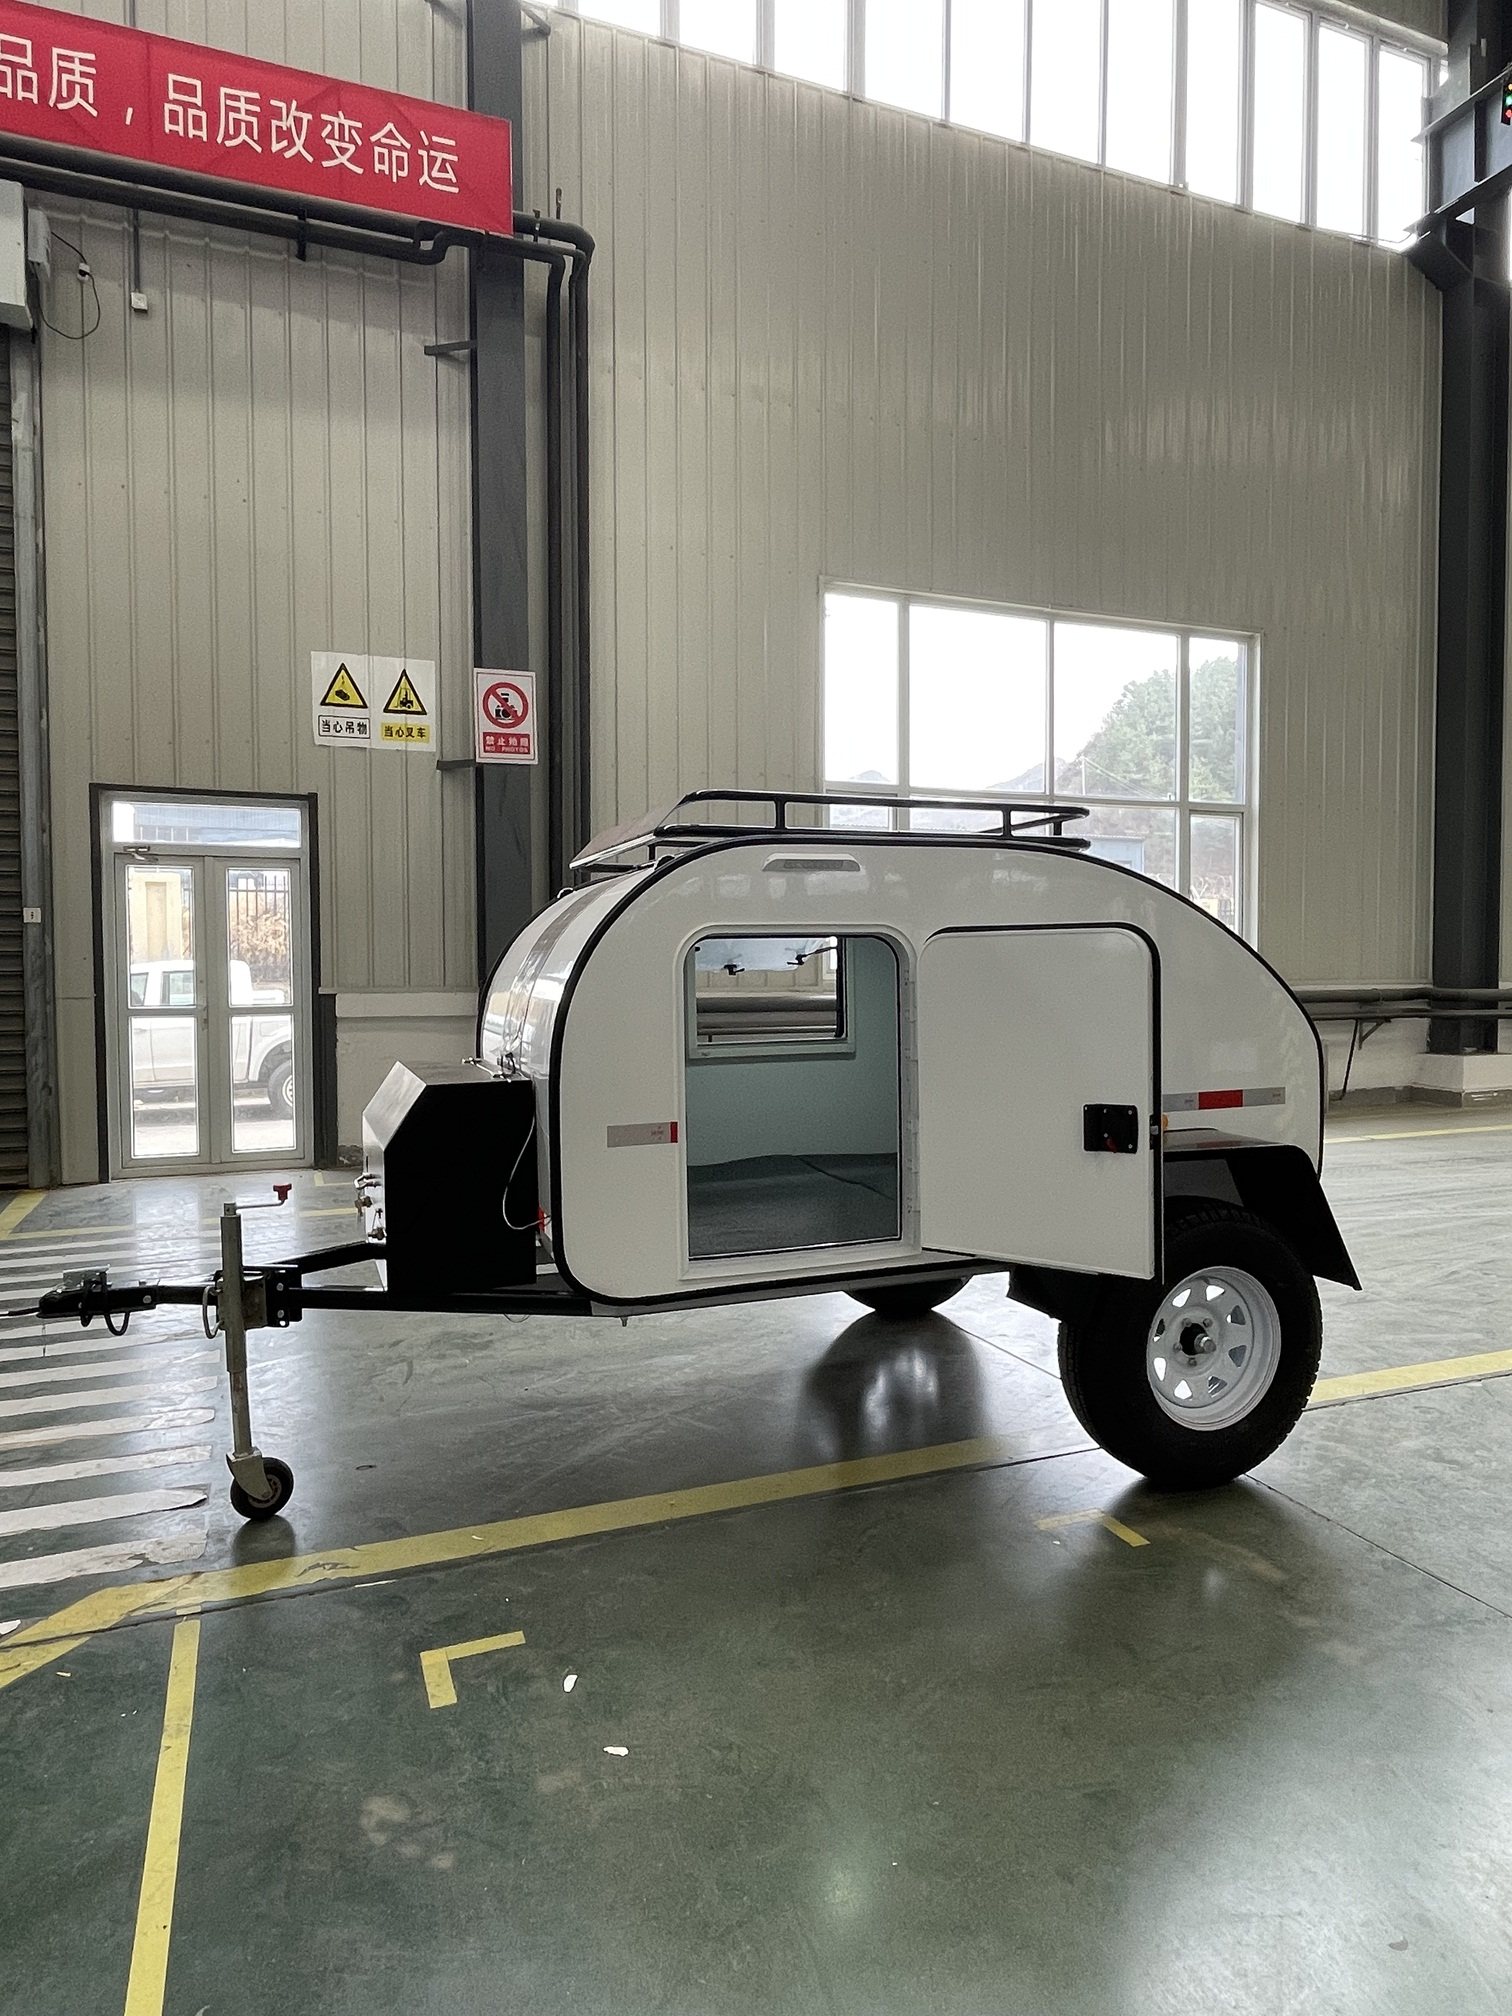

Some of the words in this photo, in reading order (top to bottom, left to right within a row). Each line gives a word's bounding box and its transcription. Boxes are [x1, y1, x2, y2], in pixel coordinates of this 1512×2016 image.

[321, 719, 368, 735] 当心吊物
[384, 725, 426, 739] 当心叉车
